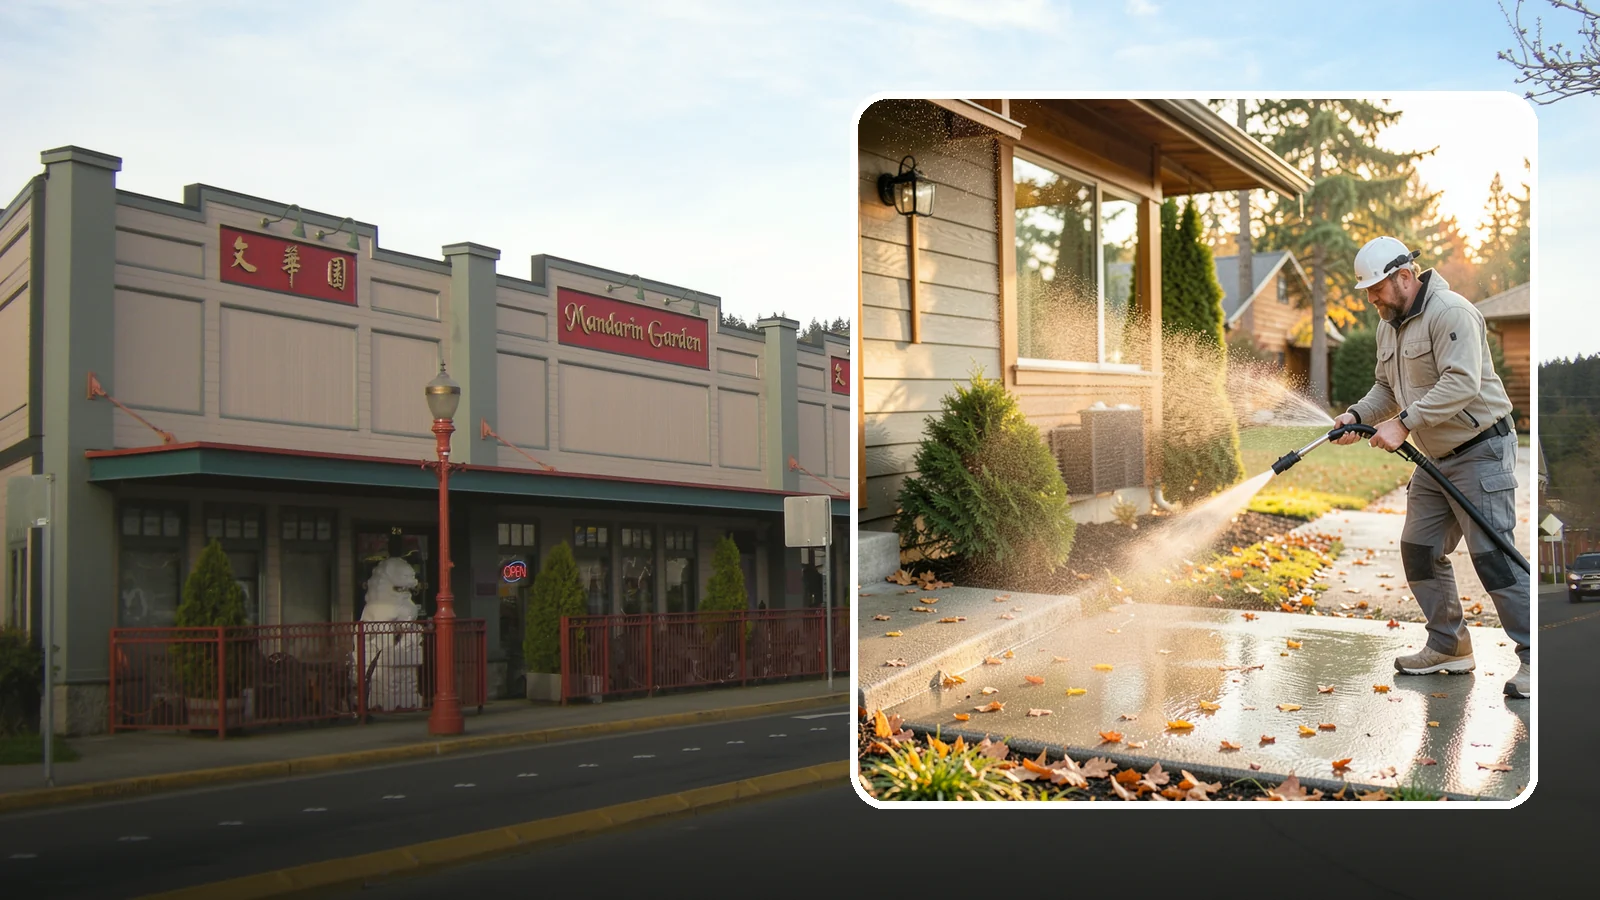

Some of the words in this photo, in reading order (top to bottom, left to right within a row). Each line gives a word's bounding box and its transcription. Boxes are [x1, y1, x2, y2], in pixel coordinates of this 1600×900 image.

[231, 235, 346, 291] 文華園
[564, 302, 644, 341] Mandarin
[647, 320, 702, 352] Garden
[503, 565, 527, 578] OPEN
